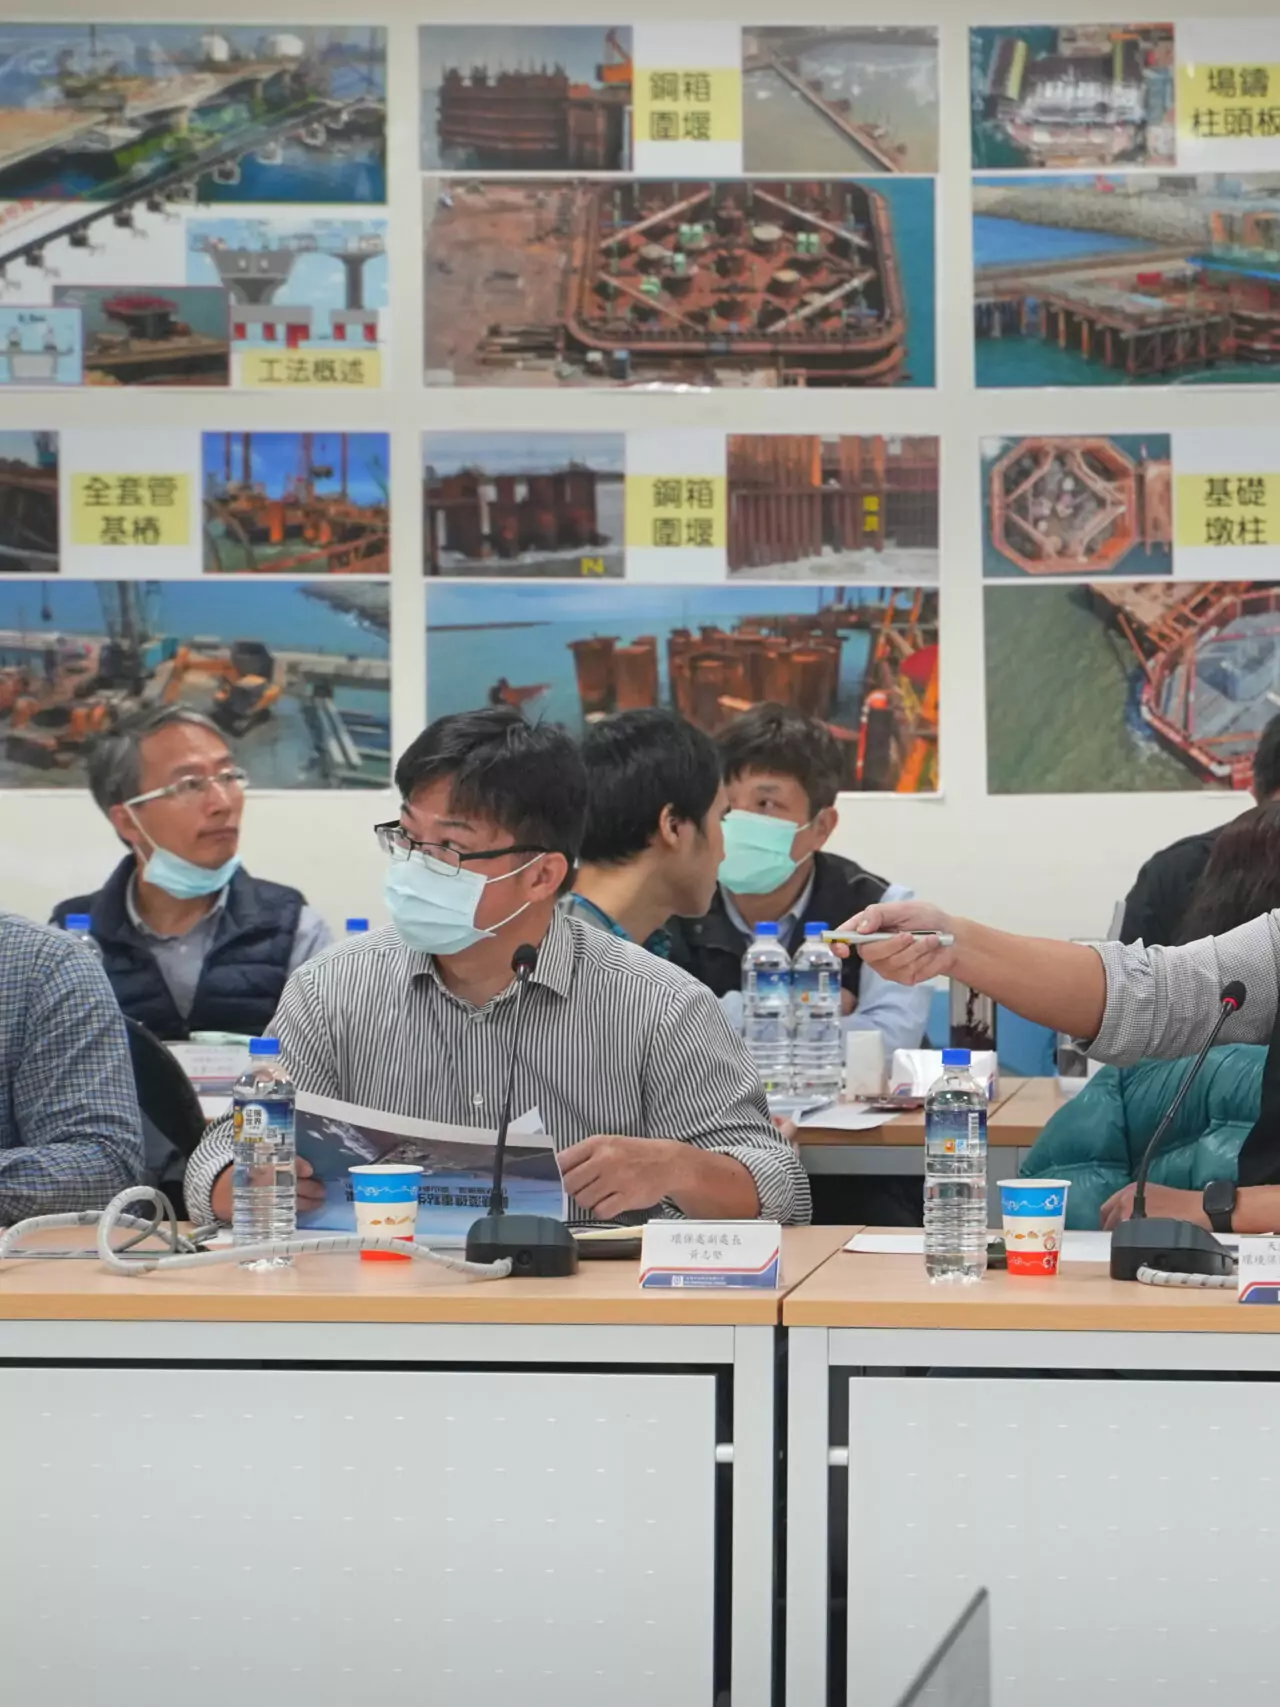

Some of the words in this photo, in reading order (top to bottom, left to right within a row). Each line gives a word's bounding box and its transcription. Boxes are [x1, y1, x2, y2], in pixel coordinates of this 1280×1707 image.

[650, 72, 711, 102] 鋼箱
[1206, 67, 1270, 98] 場鑄
[650, 111, 711, 141] 圍堰
[258, 358, 364, 383] 工法概述
[83, 476, 178, 507] 全套管
[653, 477, 714, 509] 鋼箱
[1204, 477, 1267, 507] 基礎
[652, 517, 714, 548] 圍堰
[1204, 515, 1268, 546] 墩柱
